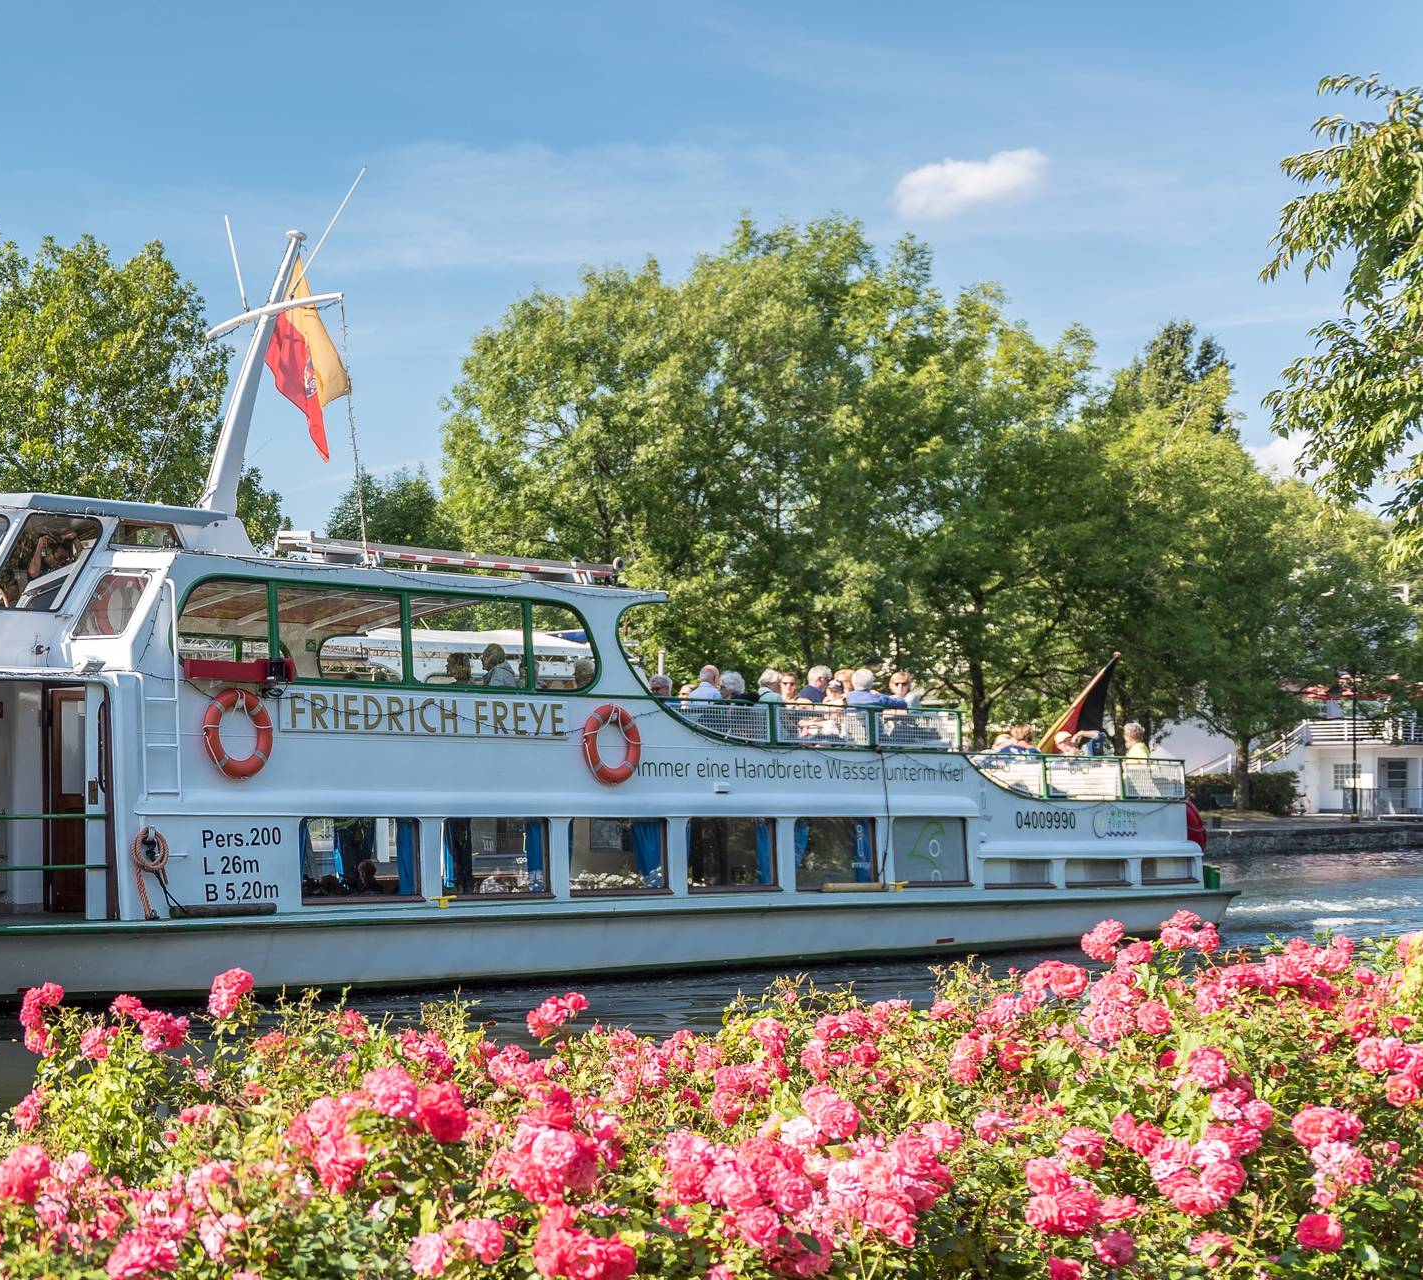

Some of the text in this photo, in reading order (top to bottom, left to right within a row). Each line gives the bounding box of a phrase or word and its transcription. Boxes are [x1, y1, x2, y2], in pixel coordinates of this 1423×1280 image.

[290, 692, 566, 737] FRIEDRICH FREYE
[637, 757, 964, 782] Immer eine Handbreite Wasser unterm Kiel
[1015, 810, 1076, 830] 04009990
[201, 826, 282, 849] Pers.200
[203, 855, 260, 875] L 26m
[205, 880, 279, 904] B 5,20m
